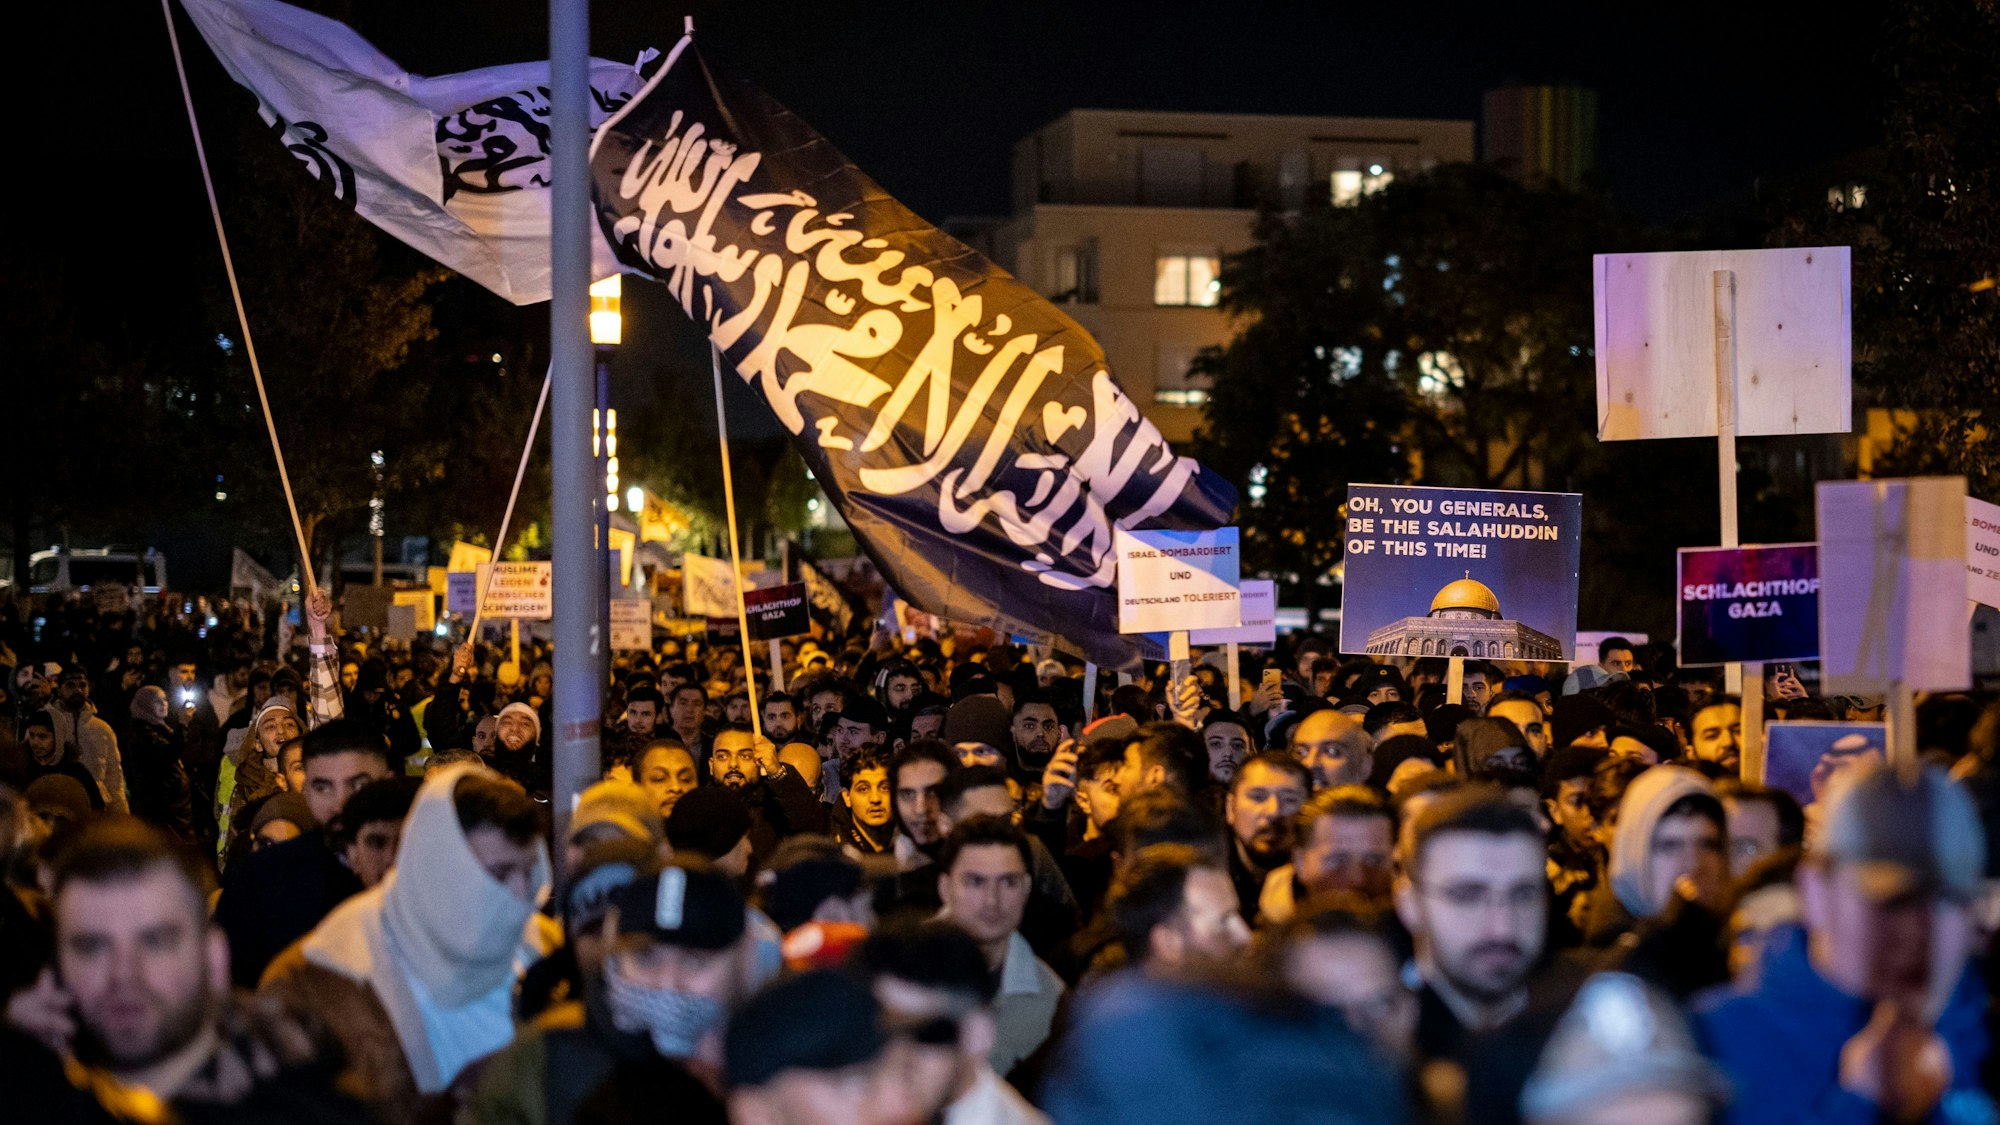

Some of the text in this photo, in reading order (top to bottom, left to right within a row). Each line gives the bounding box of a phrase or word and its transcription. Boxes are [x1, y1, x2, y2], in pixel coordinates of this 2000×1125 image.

[1350, 497, 1549, 521] OH, YOU GENERALS,
[1349, 518, 1558, 540] BE THE SALAHUDDIN
[1128, 546, 1232, 558] ISRAEL BOMBARDIERT
[1348, 539, 1487, 558] OF THIS TIME!
[1975, 542, 1999, 557] UND
[1170, 571, 1191, 580] UND
[1683, 578, 1821, 601] SCHLACHTHOF
[1125, 592, 1236, 605] DEUTSCHLAND TOLERIERT
[762, 610, 786, 621] GAZA
[1728, 601, 1783, 619] GAZA
